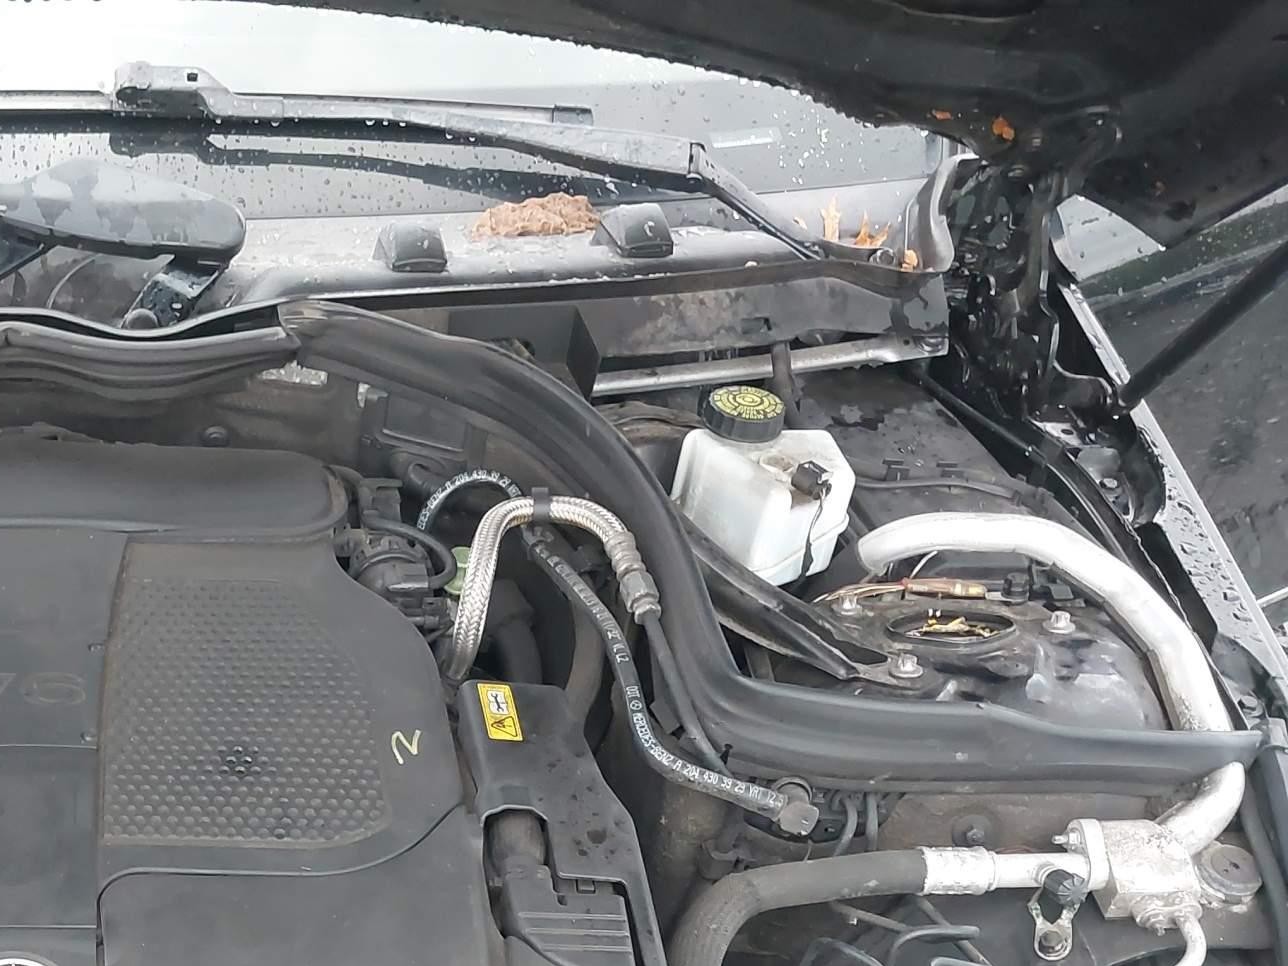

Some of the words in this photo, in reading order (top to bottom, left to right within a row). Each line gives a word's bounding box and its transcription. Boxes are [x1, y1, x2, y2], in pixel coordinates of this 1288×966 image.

[632, 712, 674, 766] MERCEDES-BENZ
[672, 759, 683, 771] A
[683, 763, 700, 779] 204
[703, 769, 719, 785] 430
